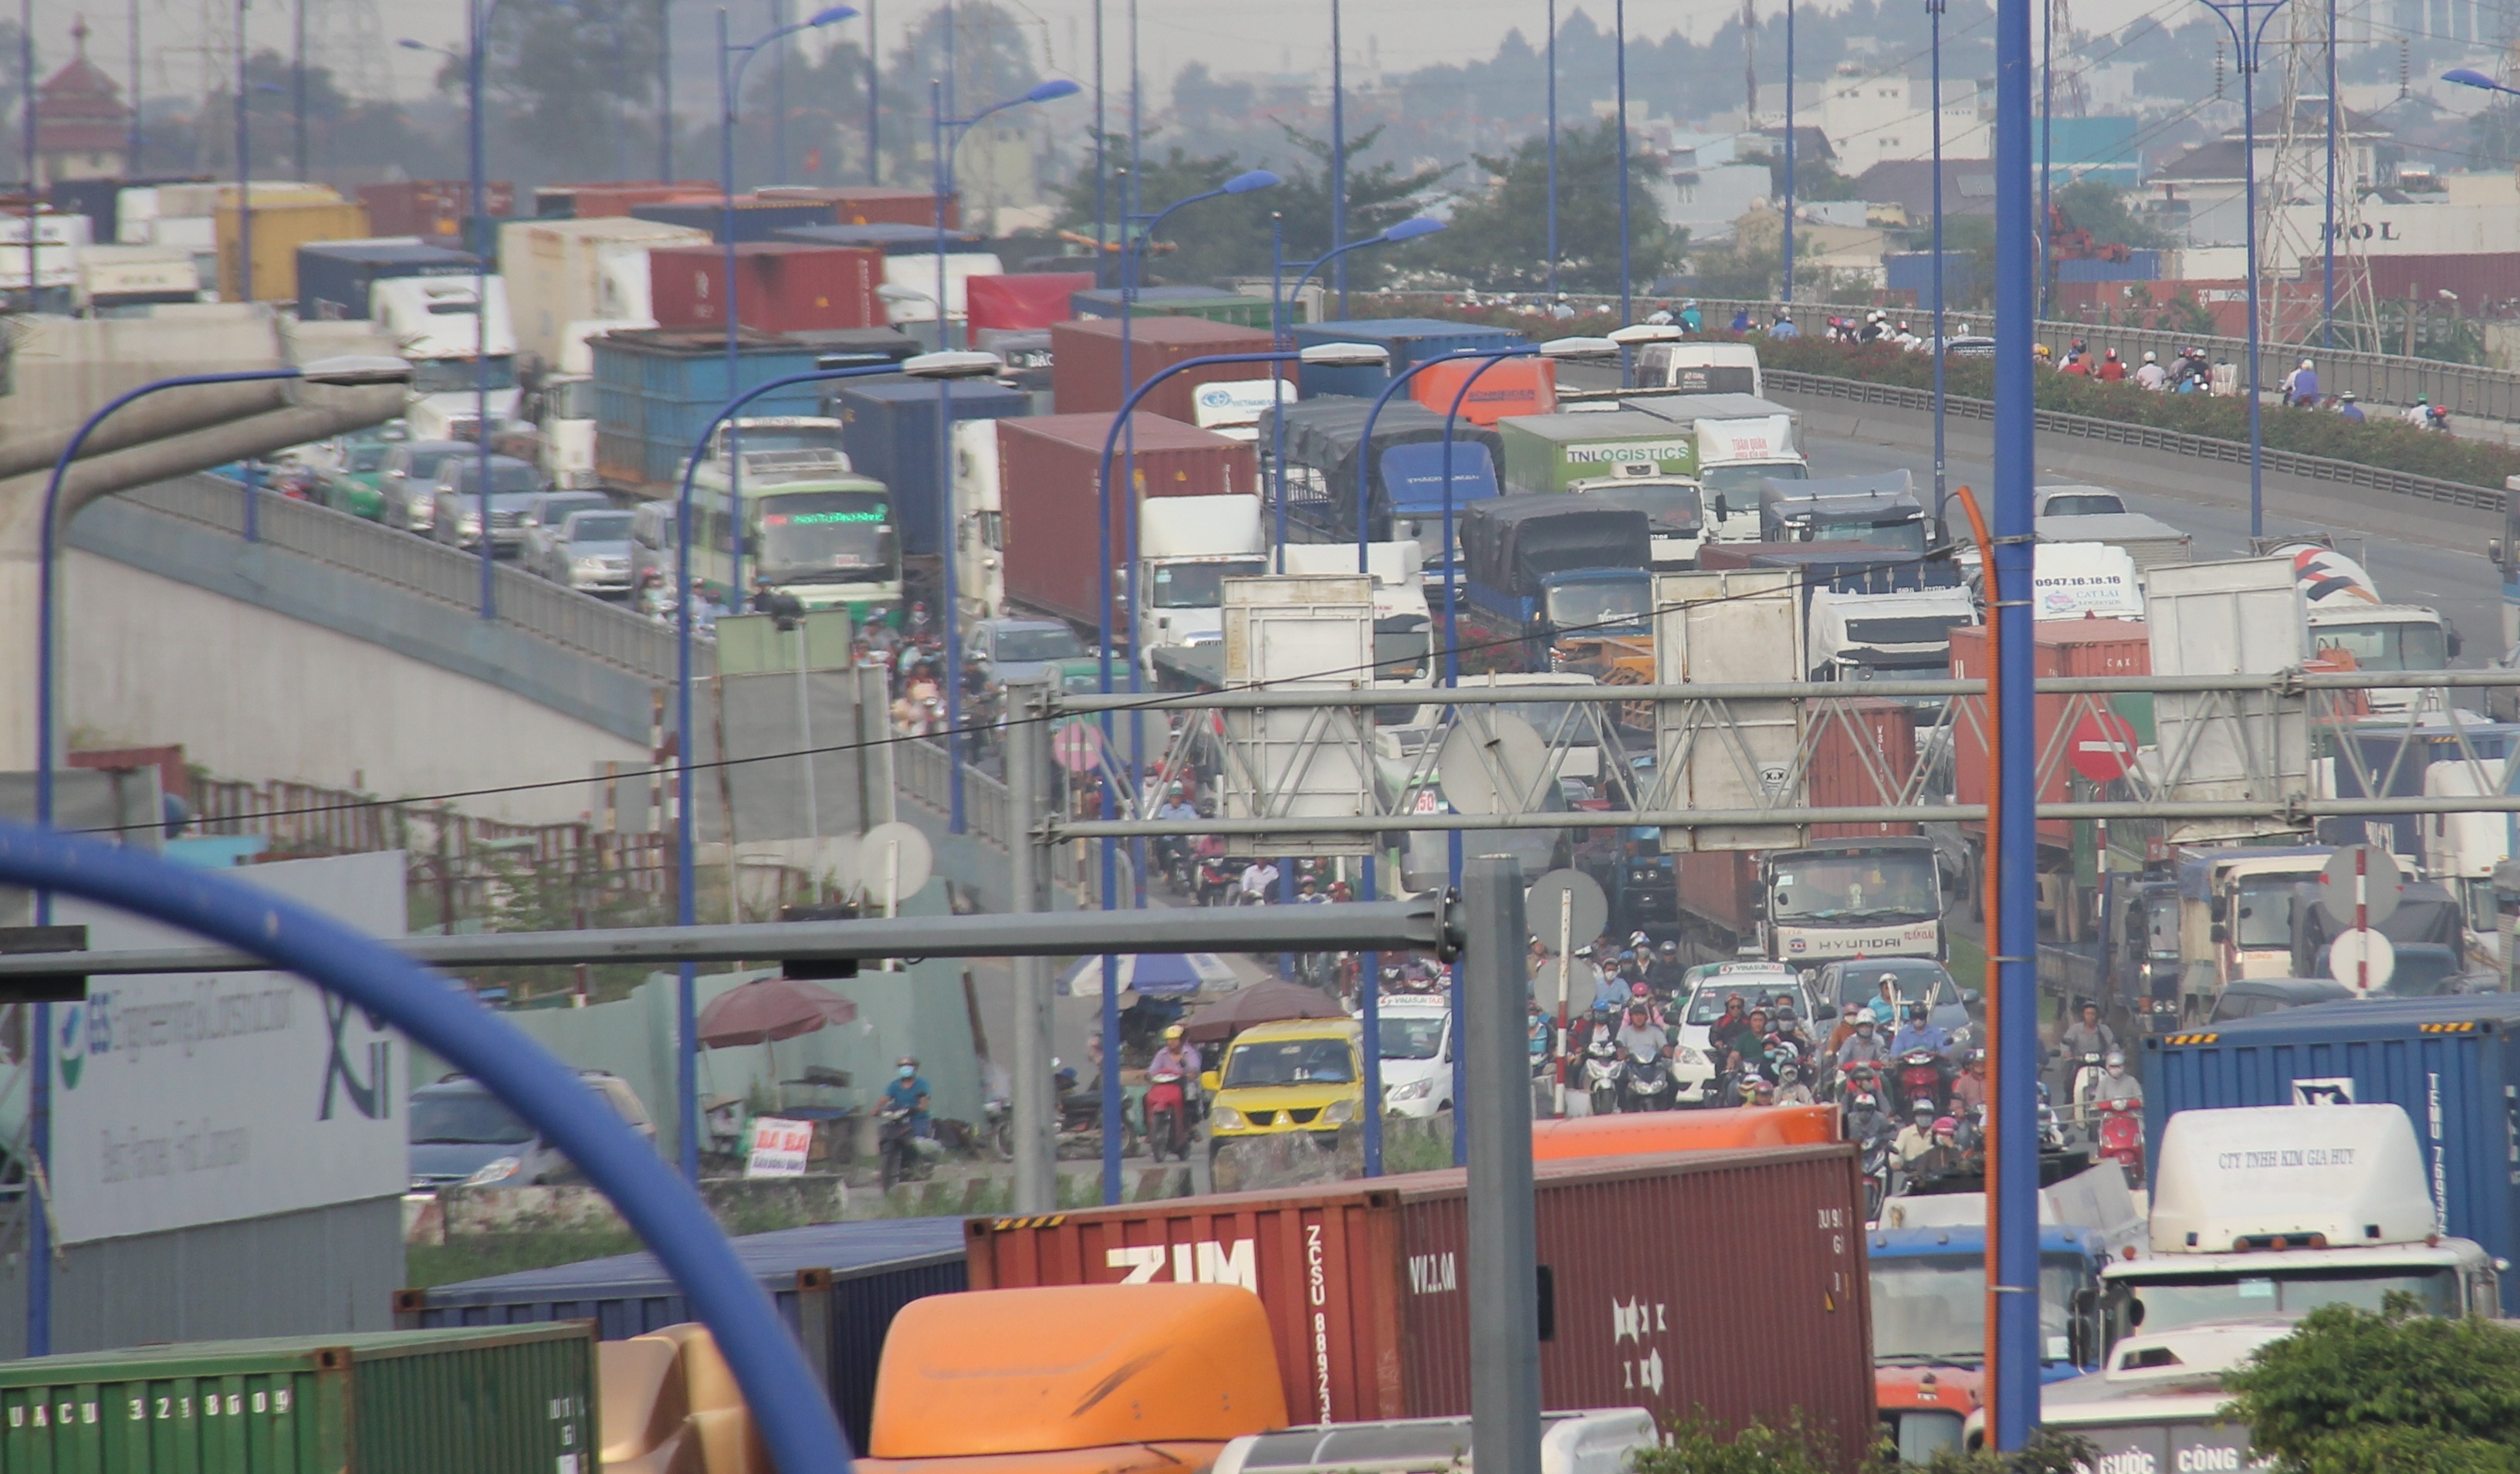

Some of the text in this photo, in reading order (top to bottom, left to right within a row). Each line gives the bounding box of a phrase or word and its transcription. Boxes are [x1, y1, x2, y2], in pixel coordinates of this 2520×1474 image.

[1819, 938, 1901, 950] HYUNDAI
[2219, 1148, 2355, 1169] CTY TNHH KIM GIA HUY
[1106, 1239, 1258, 1295] ZIM
[1307, 1225, 1325, 1306] ZCSU
[8, 1402, 99, 1427] UACU
